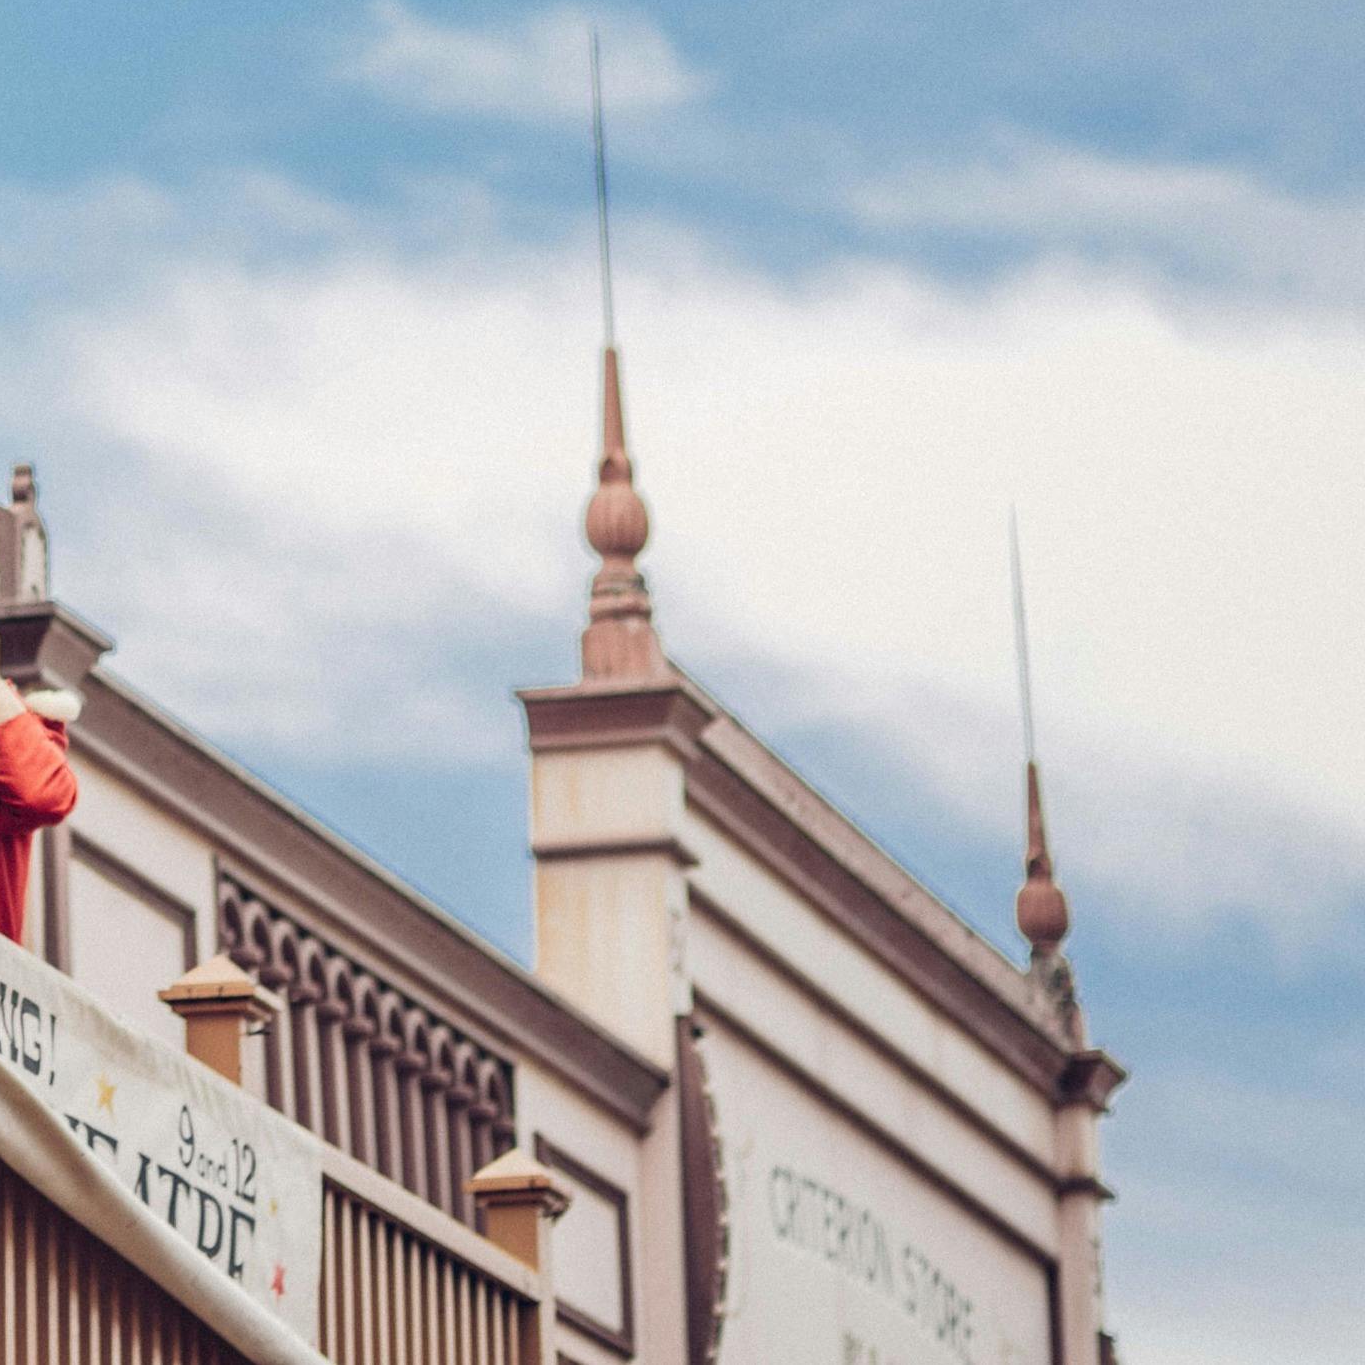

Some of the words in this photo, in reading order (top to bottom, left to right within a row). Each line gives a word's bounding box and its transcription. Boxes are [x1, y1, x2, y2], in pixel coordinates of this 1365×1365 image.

[178, 1104, 195, 1168] 9
[196, 1153, 228, 1188] and
[231, 1137, 256, 1204] 12
